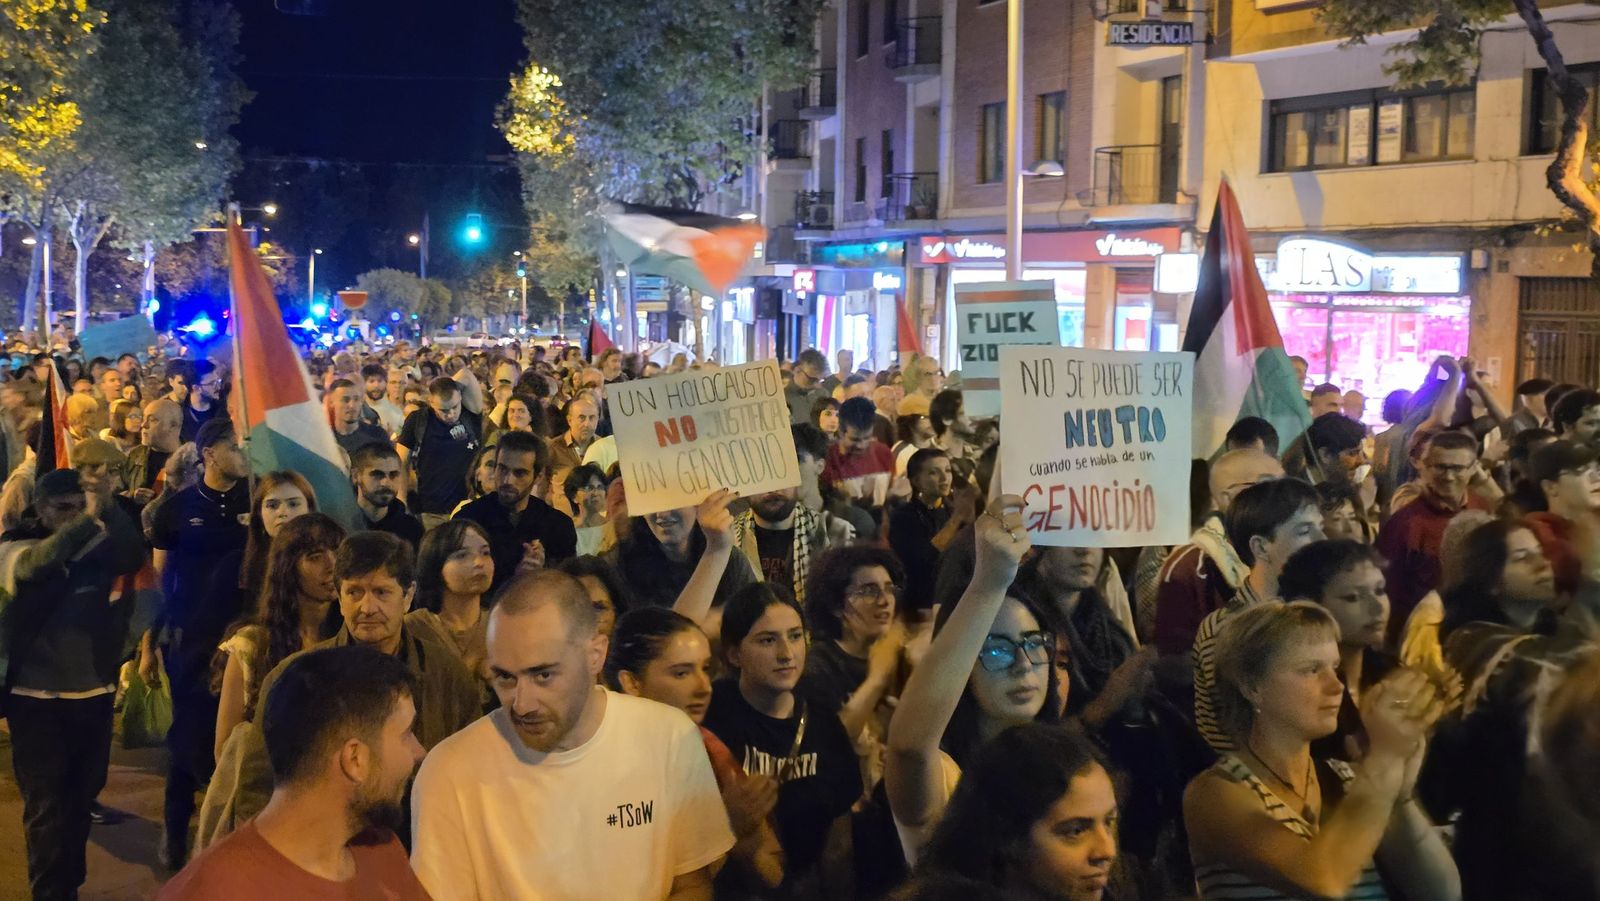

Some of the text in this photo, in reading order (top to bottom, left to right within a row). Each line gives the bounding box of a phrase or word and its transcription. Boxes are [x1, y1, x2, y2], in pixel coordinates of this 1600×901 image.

[1111, 24, 1192, 44] RESIDENCIA
[968, 312, 1036, 334] FUCK
[618, 366, 778, 416] UN HOLOCAUSTO
[1020, 358, 1182, 398] NO SE PUEDE SER
[654, 399, 785, 448] NO JUSTIFICA
[1064, 405, 1166, 449] NEUTRO
[632, 433, 787, 495] UN GENOCIDIO
[1075, 457, 1088, 471] se
[1090, 453, 1118, 468] habla
[1122, 449, 1135, 463] de
[1140, 450, 1156, 461] un
